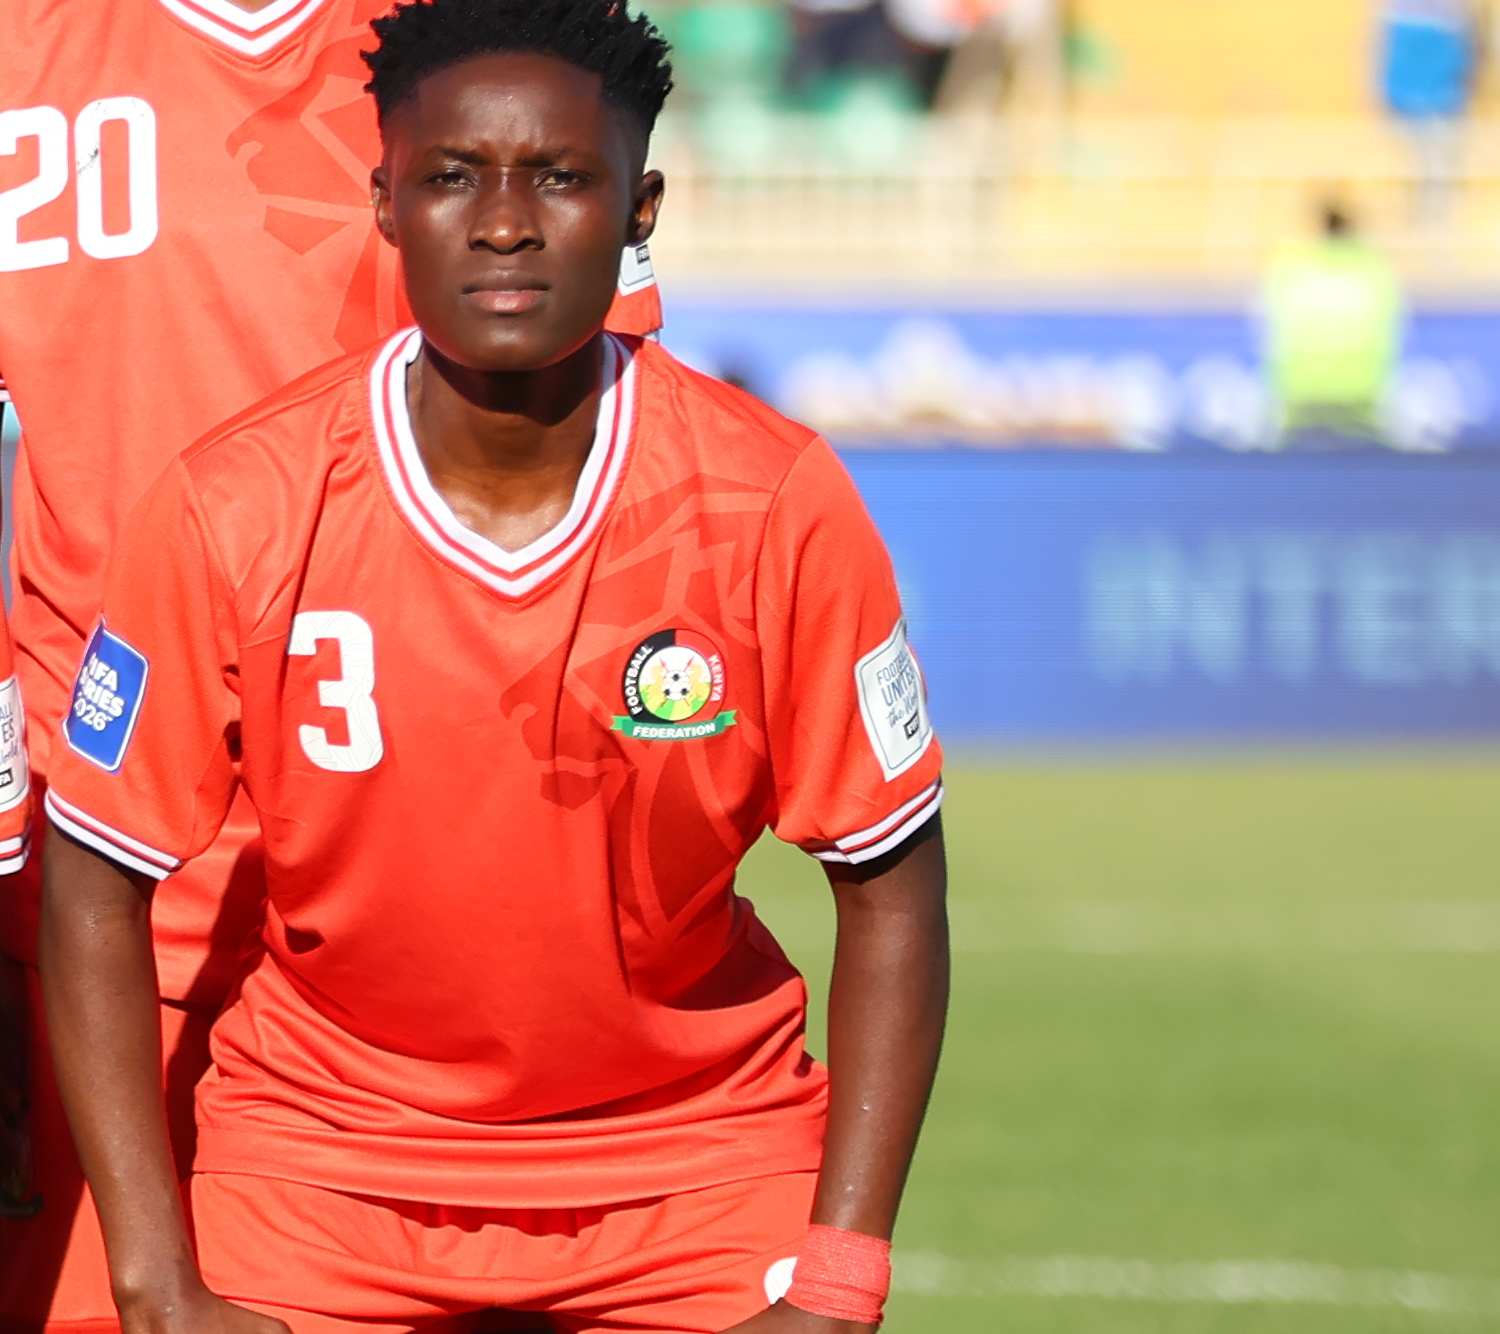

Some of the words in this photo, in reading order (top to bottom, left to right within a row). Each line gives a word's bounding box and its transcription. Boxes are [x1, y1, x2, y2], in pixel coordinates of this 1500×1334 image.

[288, 610, 385, 773] 3
[625, 644, 654, 716] FOOTBALL
[707, 653, 724, 702] KENYA
[632, 722, 717, 739] FEDERATION
